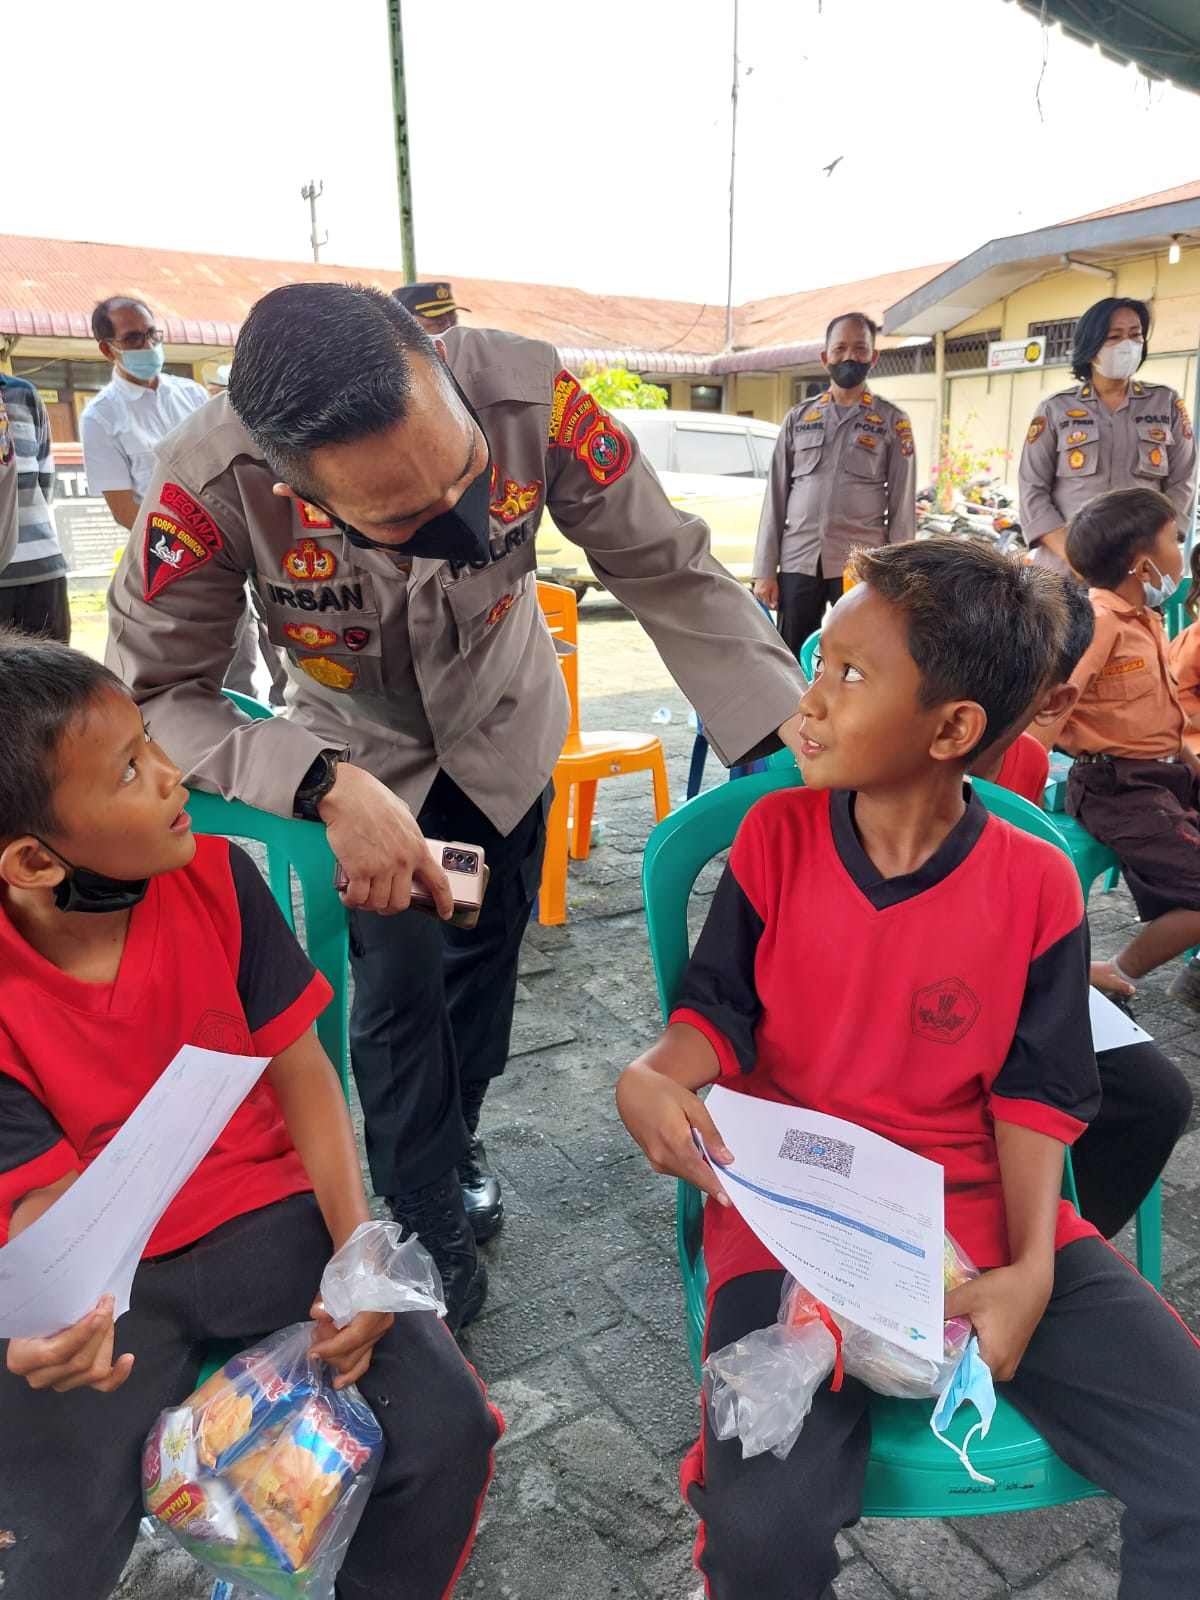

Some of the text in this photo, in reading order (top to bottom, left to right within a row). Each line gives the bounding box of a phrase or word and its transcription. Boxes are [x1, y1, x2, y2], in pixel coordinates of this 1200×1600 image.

[854, 422, 887, 436] POLRI
[1135, 415, 1169, 424] POLRI
[163, 488, 216, 548] GEGANA
[152, 516, 206, 557] KORPS BRIMOB
[267, 582, 363, 612] IRSAN
[823, 1271, 855, 1288] KARTU
